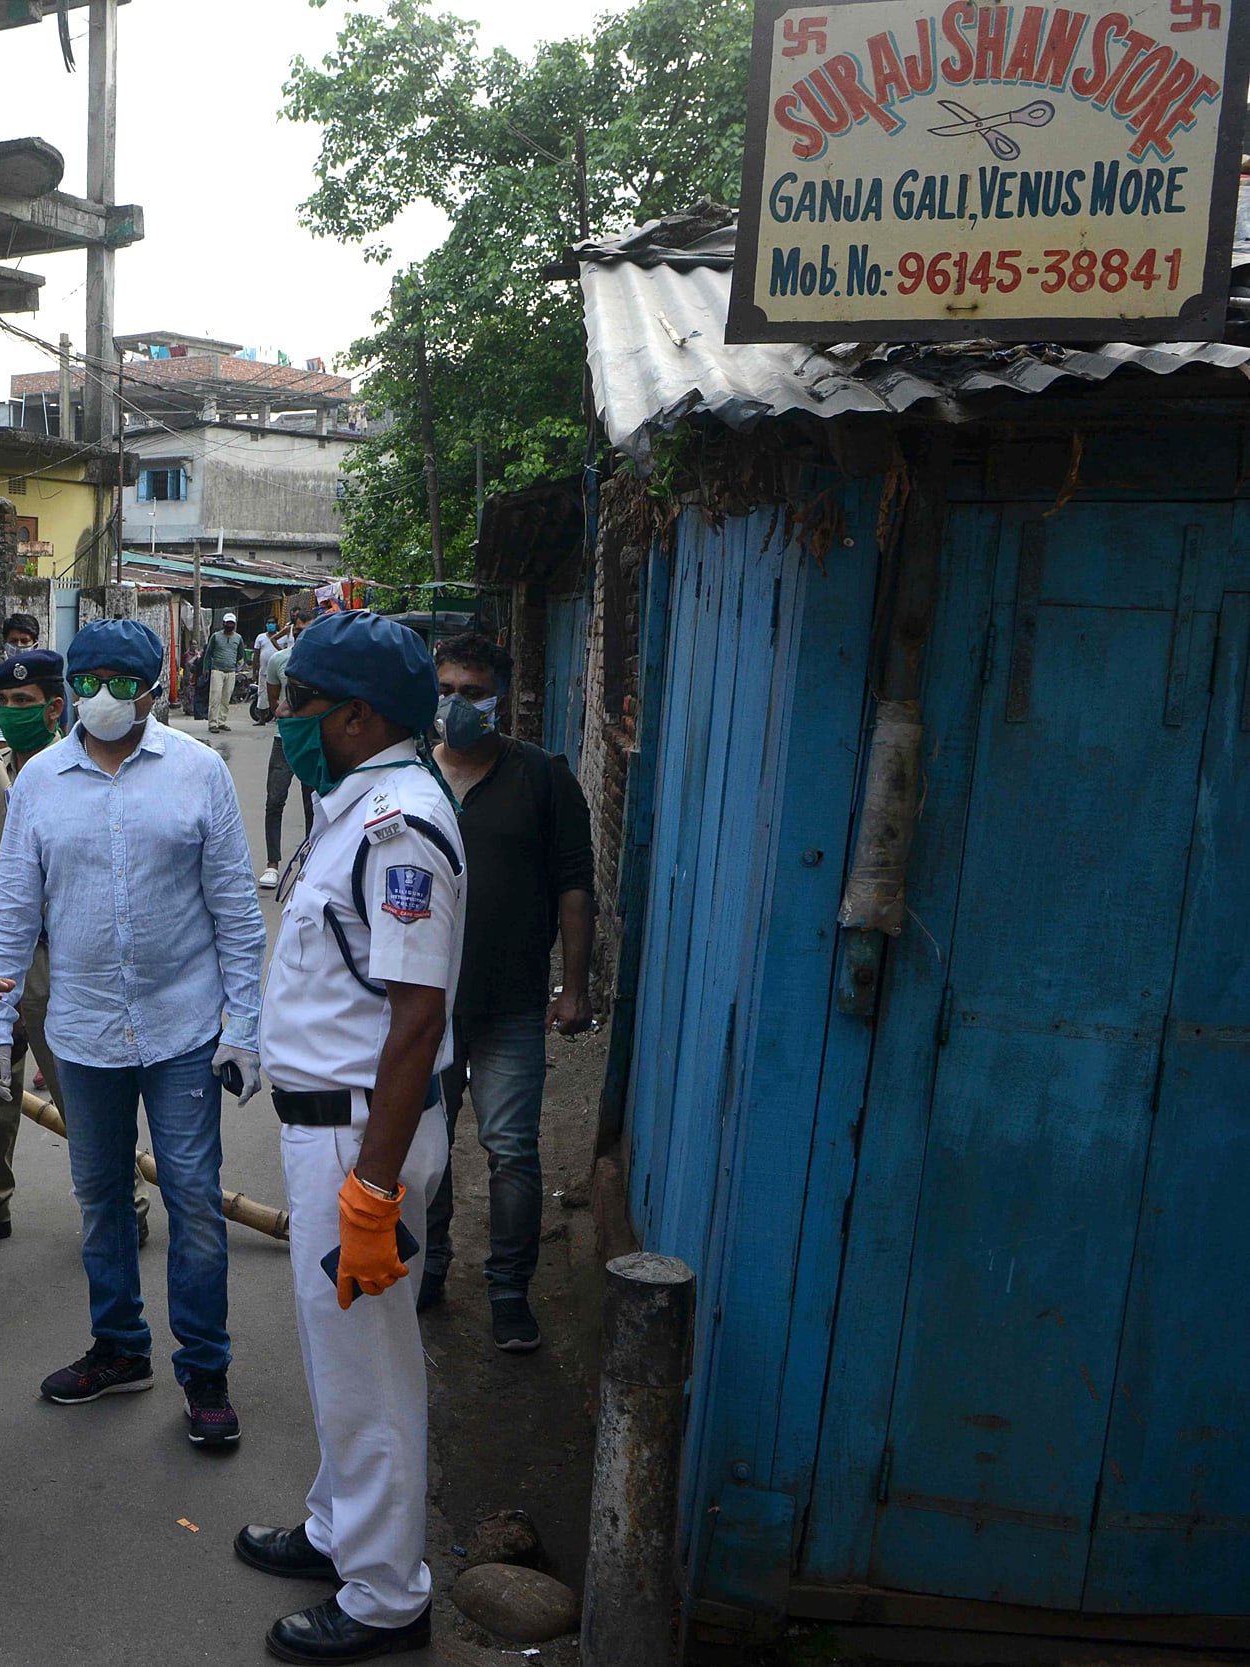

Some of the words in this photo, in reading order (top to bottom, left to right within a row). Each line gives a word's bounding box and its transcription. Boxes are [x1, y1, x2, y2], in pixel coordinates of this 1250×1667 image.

[774, 17, 934, 161] SURAJ
[941, 1, 1090, 92] SHAN
[1071, 12, 1221, 162] STORE
[770, 172, 882, 223] GANJA
[978, 166, 1086, 219] VENUS
[1090, 160, 1188, 216] MORE
[770, 244, 841, 296] Mob.
[897, 248, 1182, 295] 96145-38841
[394, 888, 423, 898] SILIGURI
